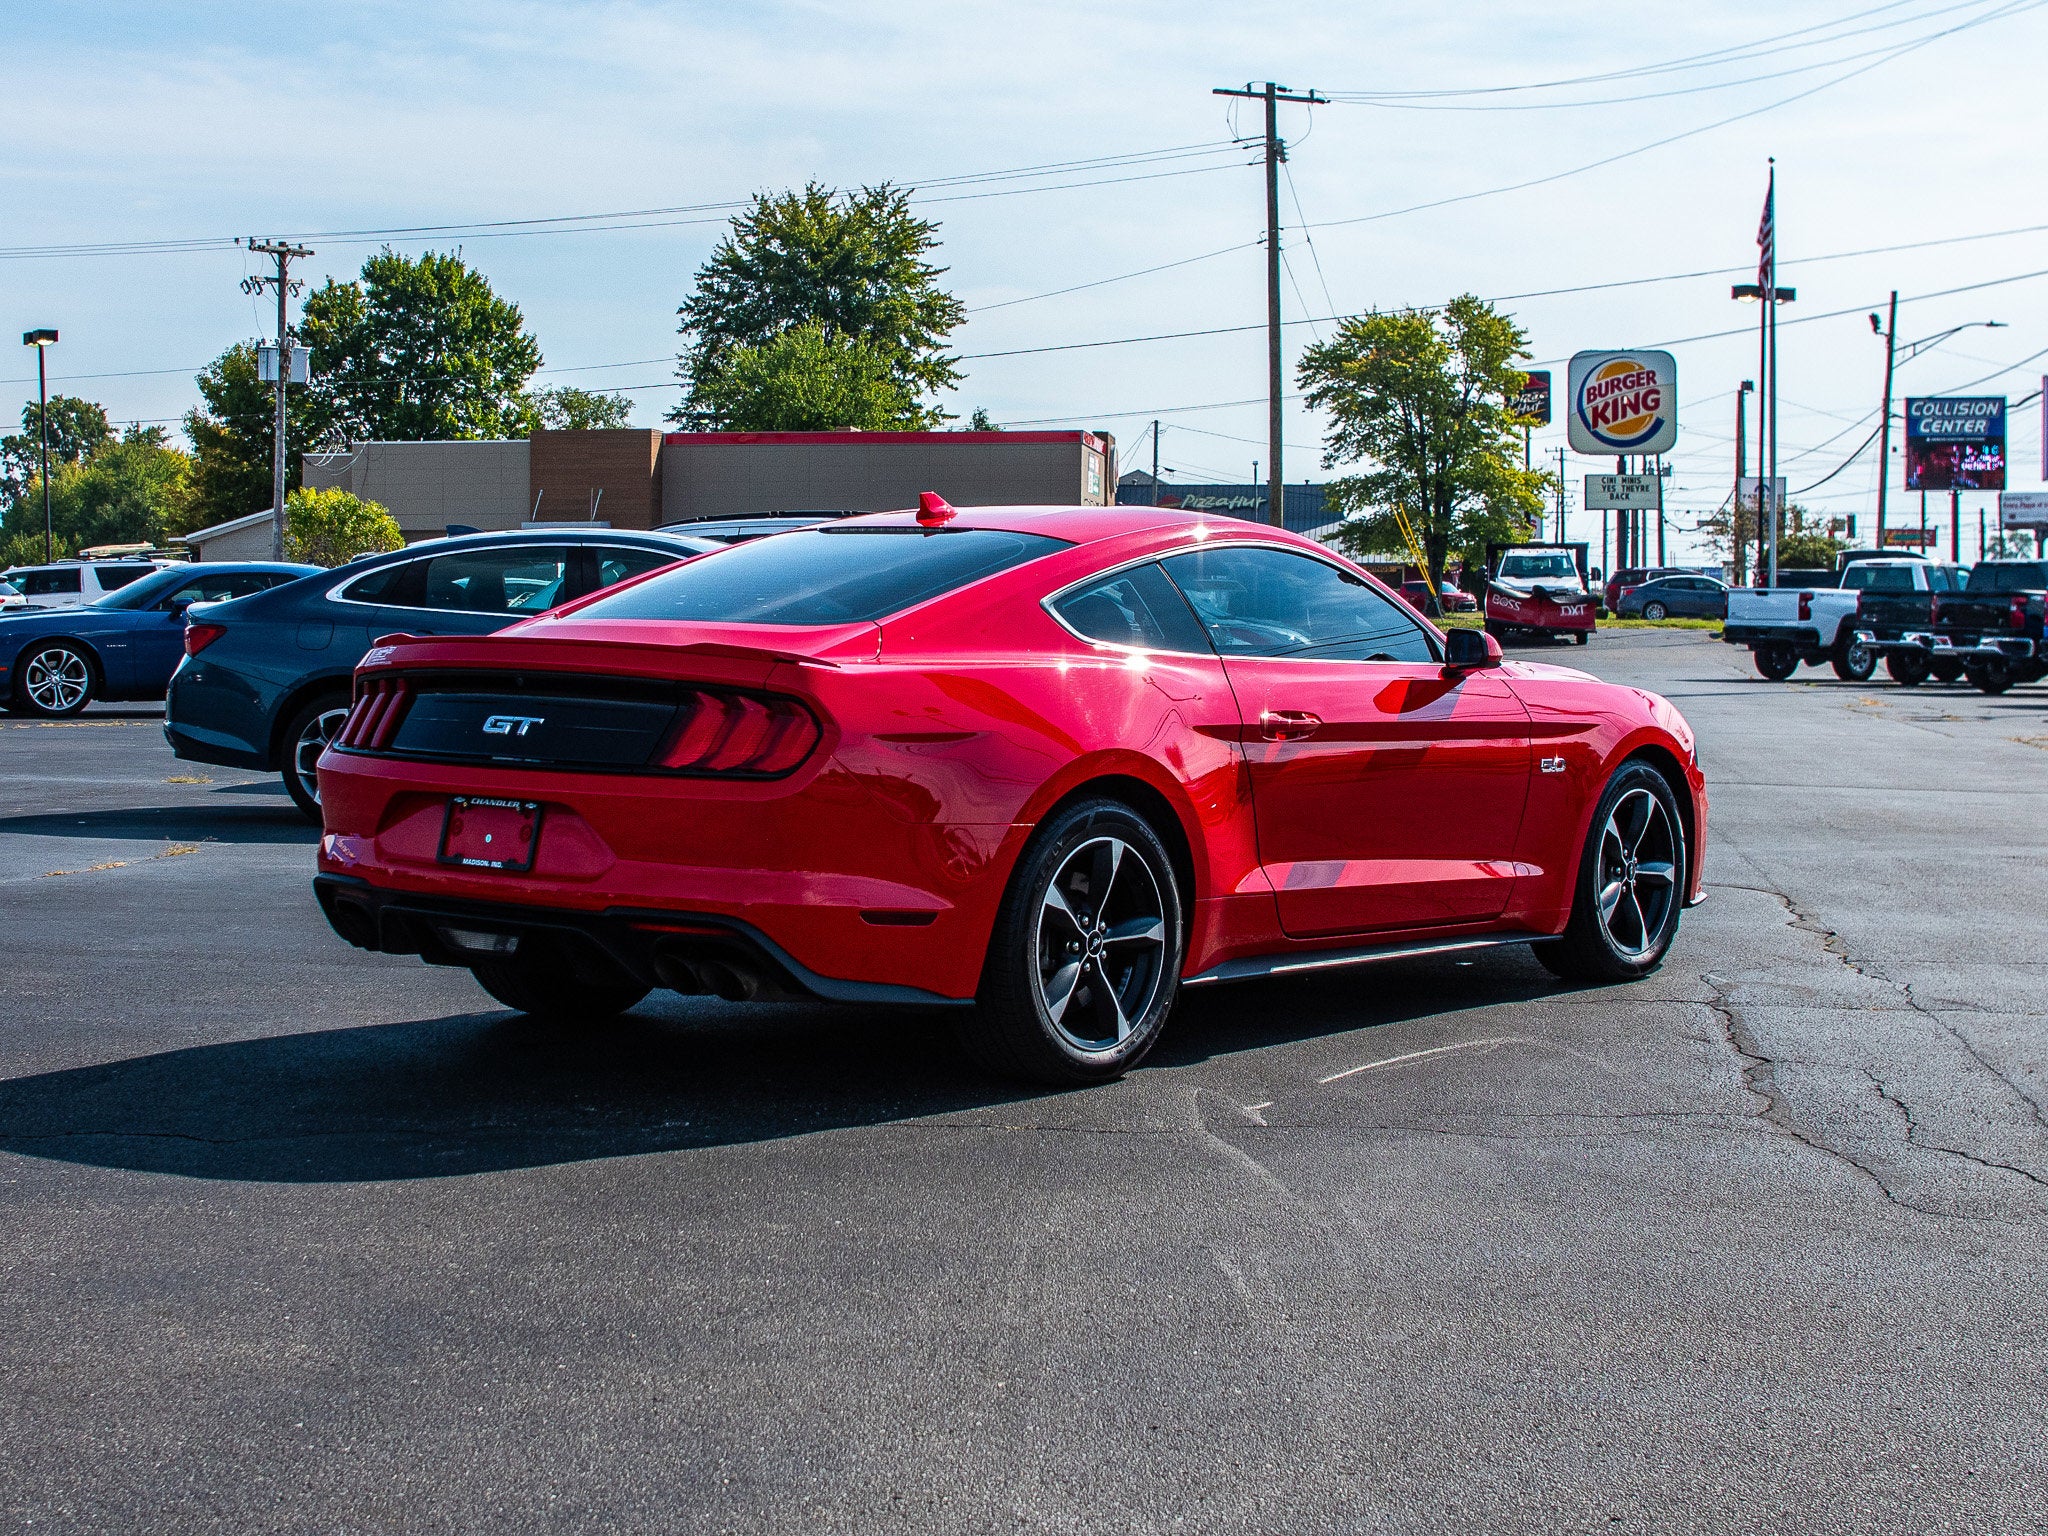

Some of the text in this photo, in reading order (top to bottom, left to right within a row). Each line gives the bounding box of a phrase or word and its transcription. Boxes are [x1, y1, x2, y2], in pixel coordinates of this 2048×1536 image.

[1586, 369, 1657, 405] BURGER
[1515, 401, 1544, 416] Hut
[1591, 388, 1661, 430] KING
[1911, 401, 1999, 417] COLLISION
[1920, 419, 1987, 434] CENTER
[1492, 593, 1522, 611] BOSS
[1561, 604, 1588, 616] DXT
[482, 715, 545, 736] GT
[1541, 757, 1566, 773] 5.0
[470, 797, 521, 808] CHANDLER
